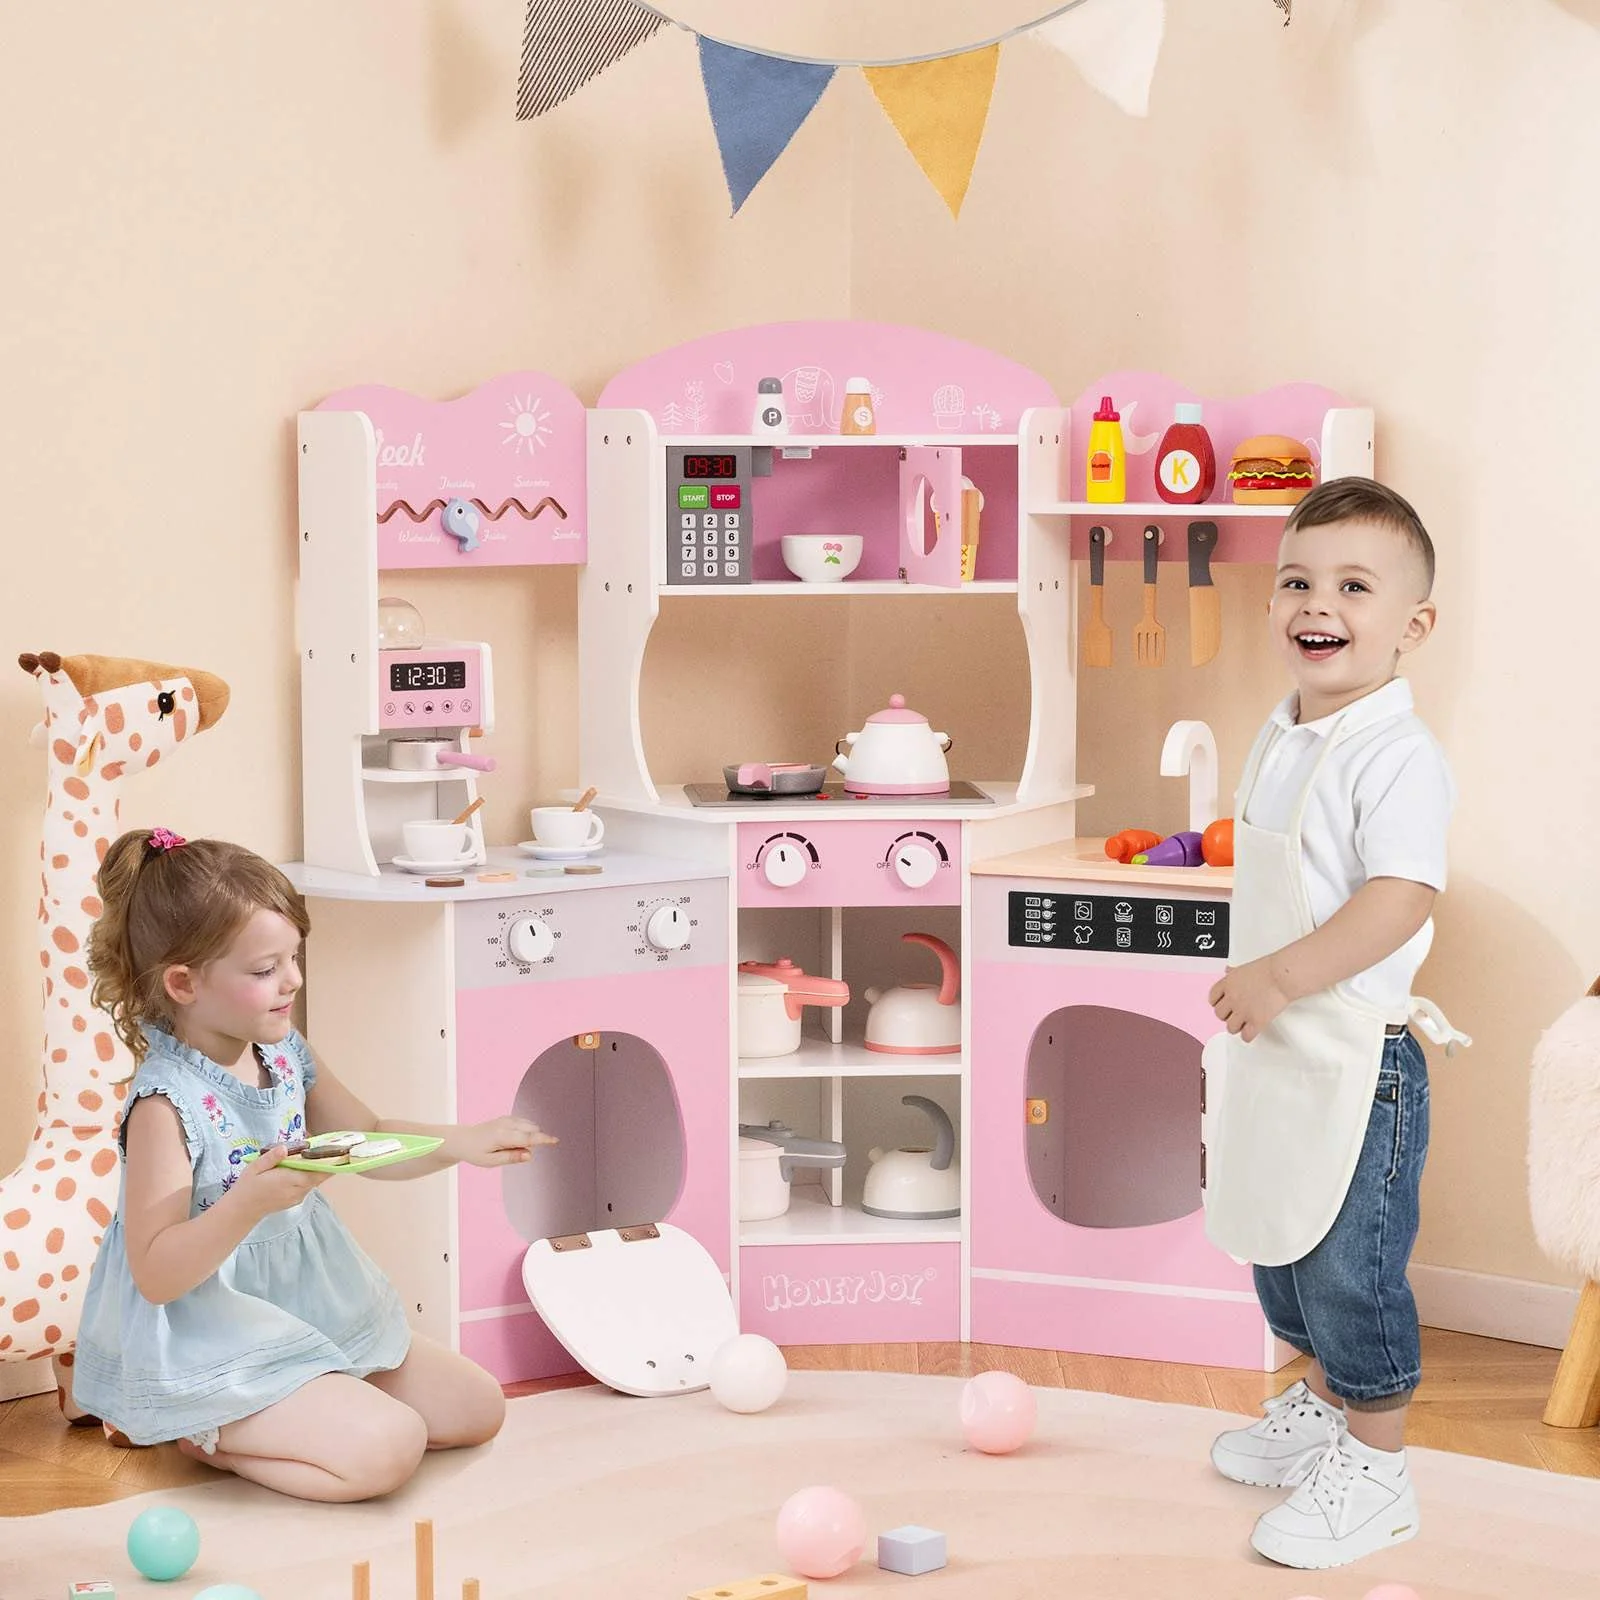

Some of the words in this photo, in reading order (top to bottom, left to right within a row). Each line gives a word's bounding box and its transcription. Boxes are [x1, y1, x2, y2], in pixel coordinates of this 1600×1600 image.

[768, 411, 777, 423] P
[859, 411, 868, 423] S
[376, 428, 425, 467] eek
[688, 458, 732, 475] 09:30
[1172, 458, 1188, 484] K
[682, 494, 706, 502] START
[716, 493, 736, 501] STOP
[686, 517, 691, 526] 1
[707, 517, 714, 526] 2
[728, 517, 735, 526] 3
[685, 533, 692, 541] 4
[707, 533, 714, 541] 5
[728, 533, 735, 541] 6
[685, 549, 692, 558] 7
[707, 549, 714, 558] 8
[728, 549, 735, 558] 9
[707, 565, 714, 574] 0
[408, 666, 446, 686] 12:30
[940, 861, 952, 869] ON
[637, 900, 645, 908] 50
[679, 896, 691, 904] 350
[497, 912, 506, 920] 50
[542, 908, 554, 916] 350
[626, 924, 638, 932] 100
[487, 937, 499, 945] 100
[634, 947, 646, 955] 150
[680, 943, 691, 951] 250
[495, 960, 507, 968] 150
[542, 956, 555, 964] 250
[656, 954, 669, 962] 200
[519, 967, 531, 975] 200
[762, 1274, 864, 1312] HONEY
